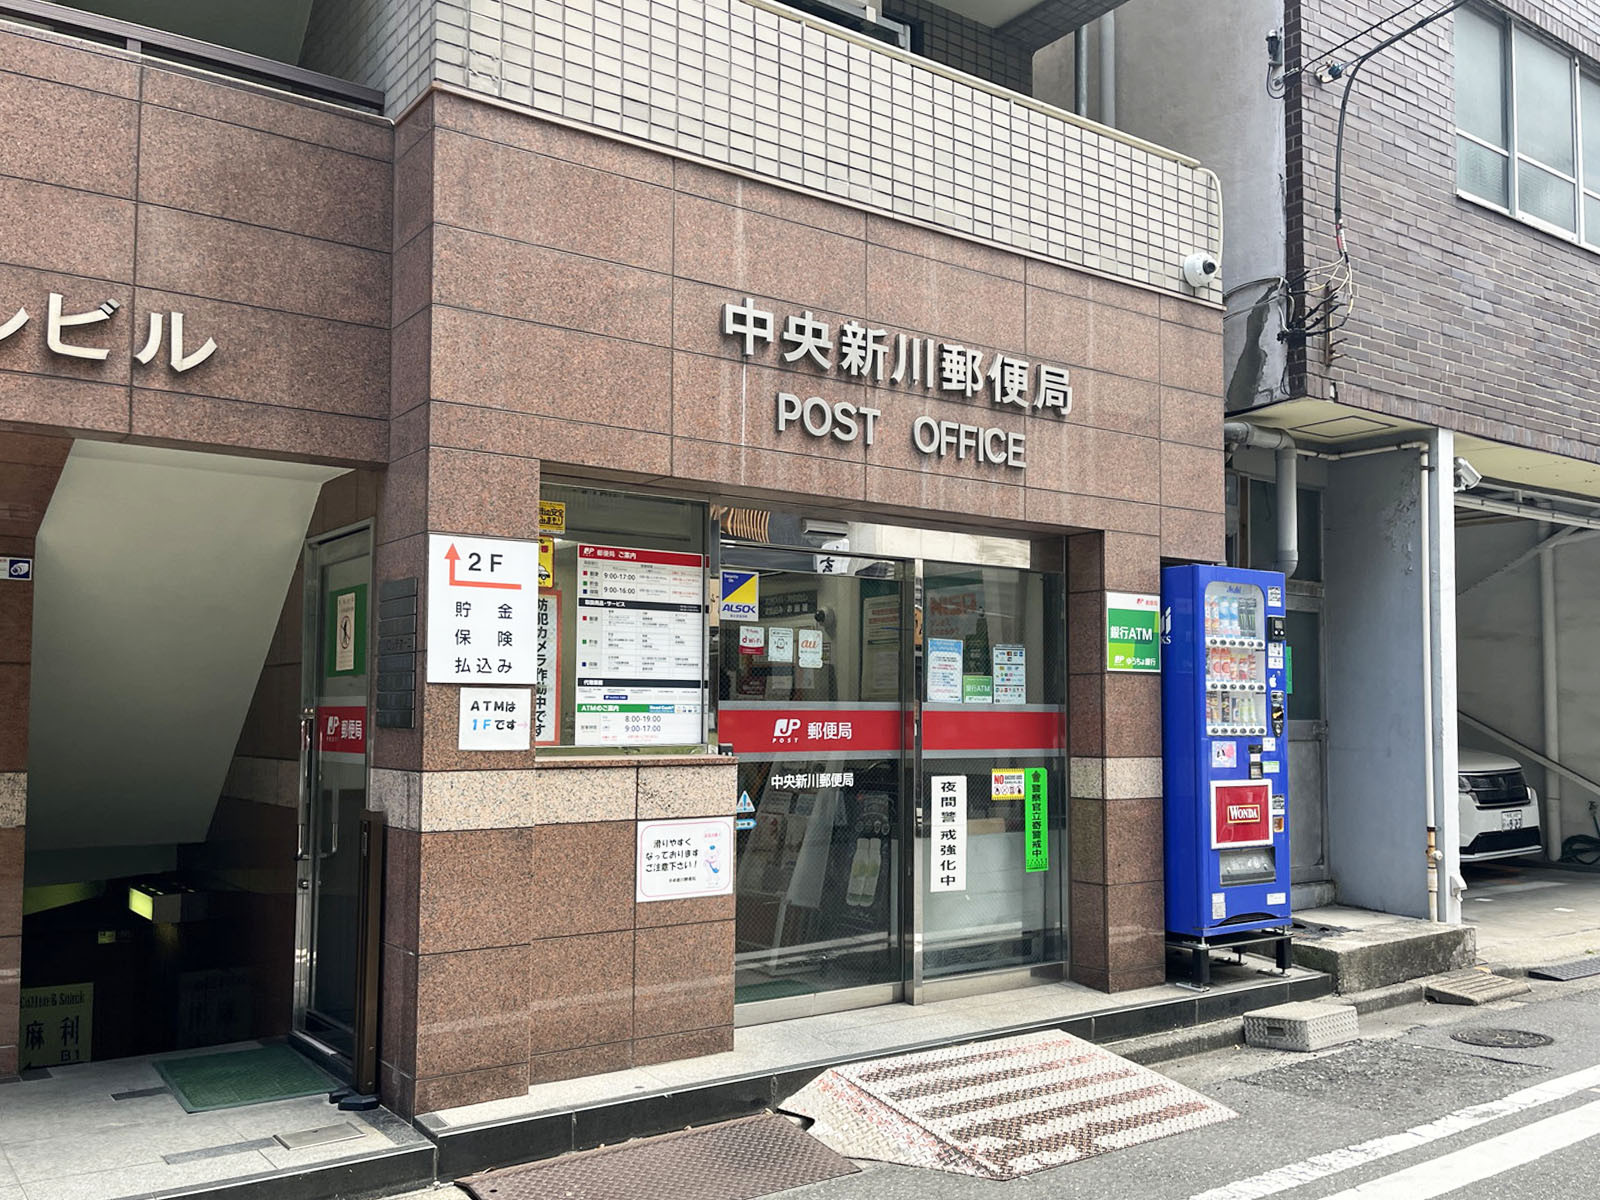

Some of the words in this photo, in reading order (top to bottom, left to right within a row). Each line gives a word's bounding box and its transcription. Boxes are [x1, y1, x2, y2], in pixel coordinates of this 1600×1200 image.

[722, 298, 1073, 416] 中央新川郵便局
[777, 393, 881, 445] POST
[914, 416, 1027, 469] OFFICE
[468, 552, 503, 572] 2F
[722, 603, 756, 614] ALSOK
[1110, 625, 1153, 641] 銀行ATM
[455, 657, 514, 674] 払込み
[470, 700, 516, 713] ATMは
[341, 720, 362, 740] 郵便局
[472, 719, 517, 731] 1Fです
[807, 722, 852, 740] 郵便局
[771, 773, 854, 790] 中央新川郵便局
[1031, 784, 1042, 858] 警察官立寄警戒中
[1229, 806, 1258, 820] WONDA
[940, 781, 957, 886] 夜間警戒強化中
[653, 838, 692, 849] 滑りやすく
[645, 849, 699, 861] なっております
